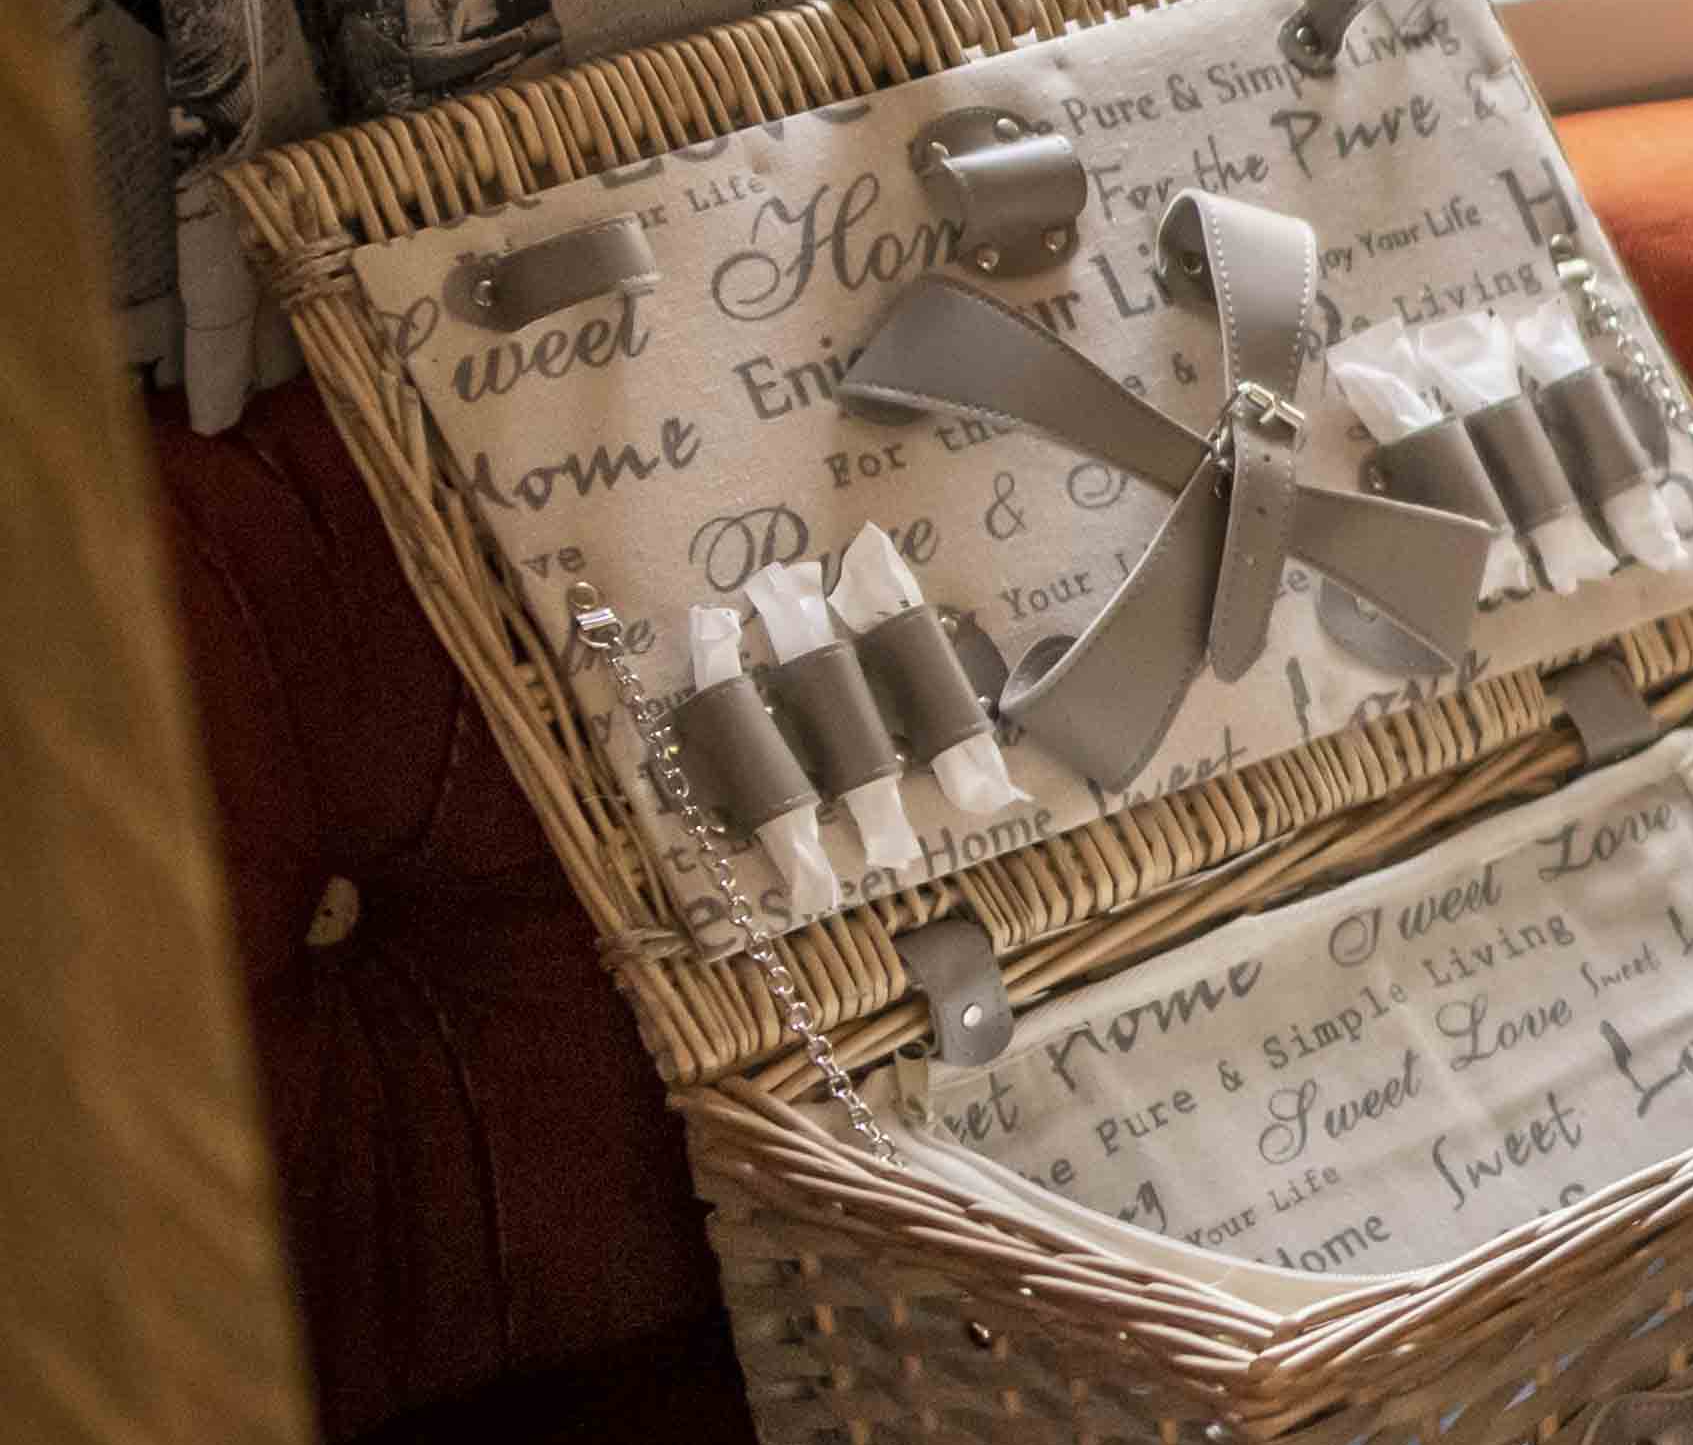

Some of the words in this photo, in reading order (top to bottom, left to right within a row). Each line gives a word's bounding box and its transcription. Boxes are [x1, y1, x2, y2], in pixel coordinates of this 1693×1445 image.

[1062, 90, 1157, 137] Pure
[1166, 72, 1204, 114] &
[1423, 195, 1484, 238] Life
[822, 440, 907, 492] For
[984, 470, 1030, 543] &
[1000, 566, 1095, 622] Your
[1095, 1086, 1199, 1158] Pure
[1216, 1057, 1244, 1095] &
[1261, 978, 1410, 1072] Simple
[1426, 912, 1577, 988] Living
[1257, 1047, 1424, 1166] Sweet
[1434, 993, 1573, 1073] Love
[1431, 1090, 1584, 1214] Sweet
[1266, 1162, 1342, 1215] Life
